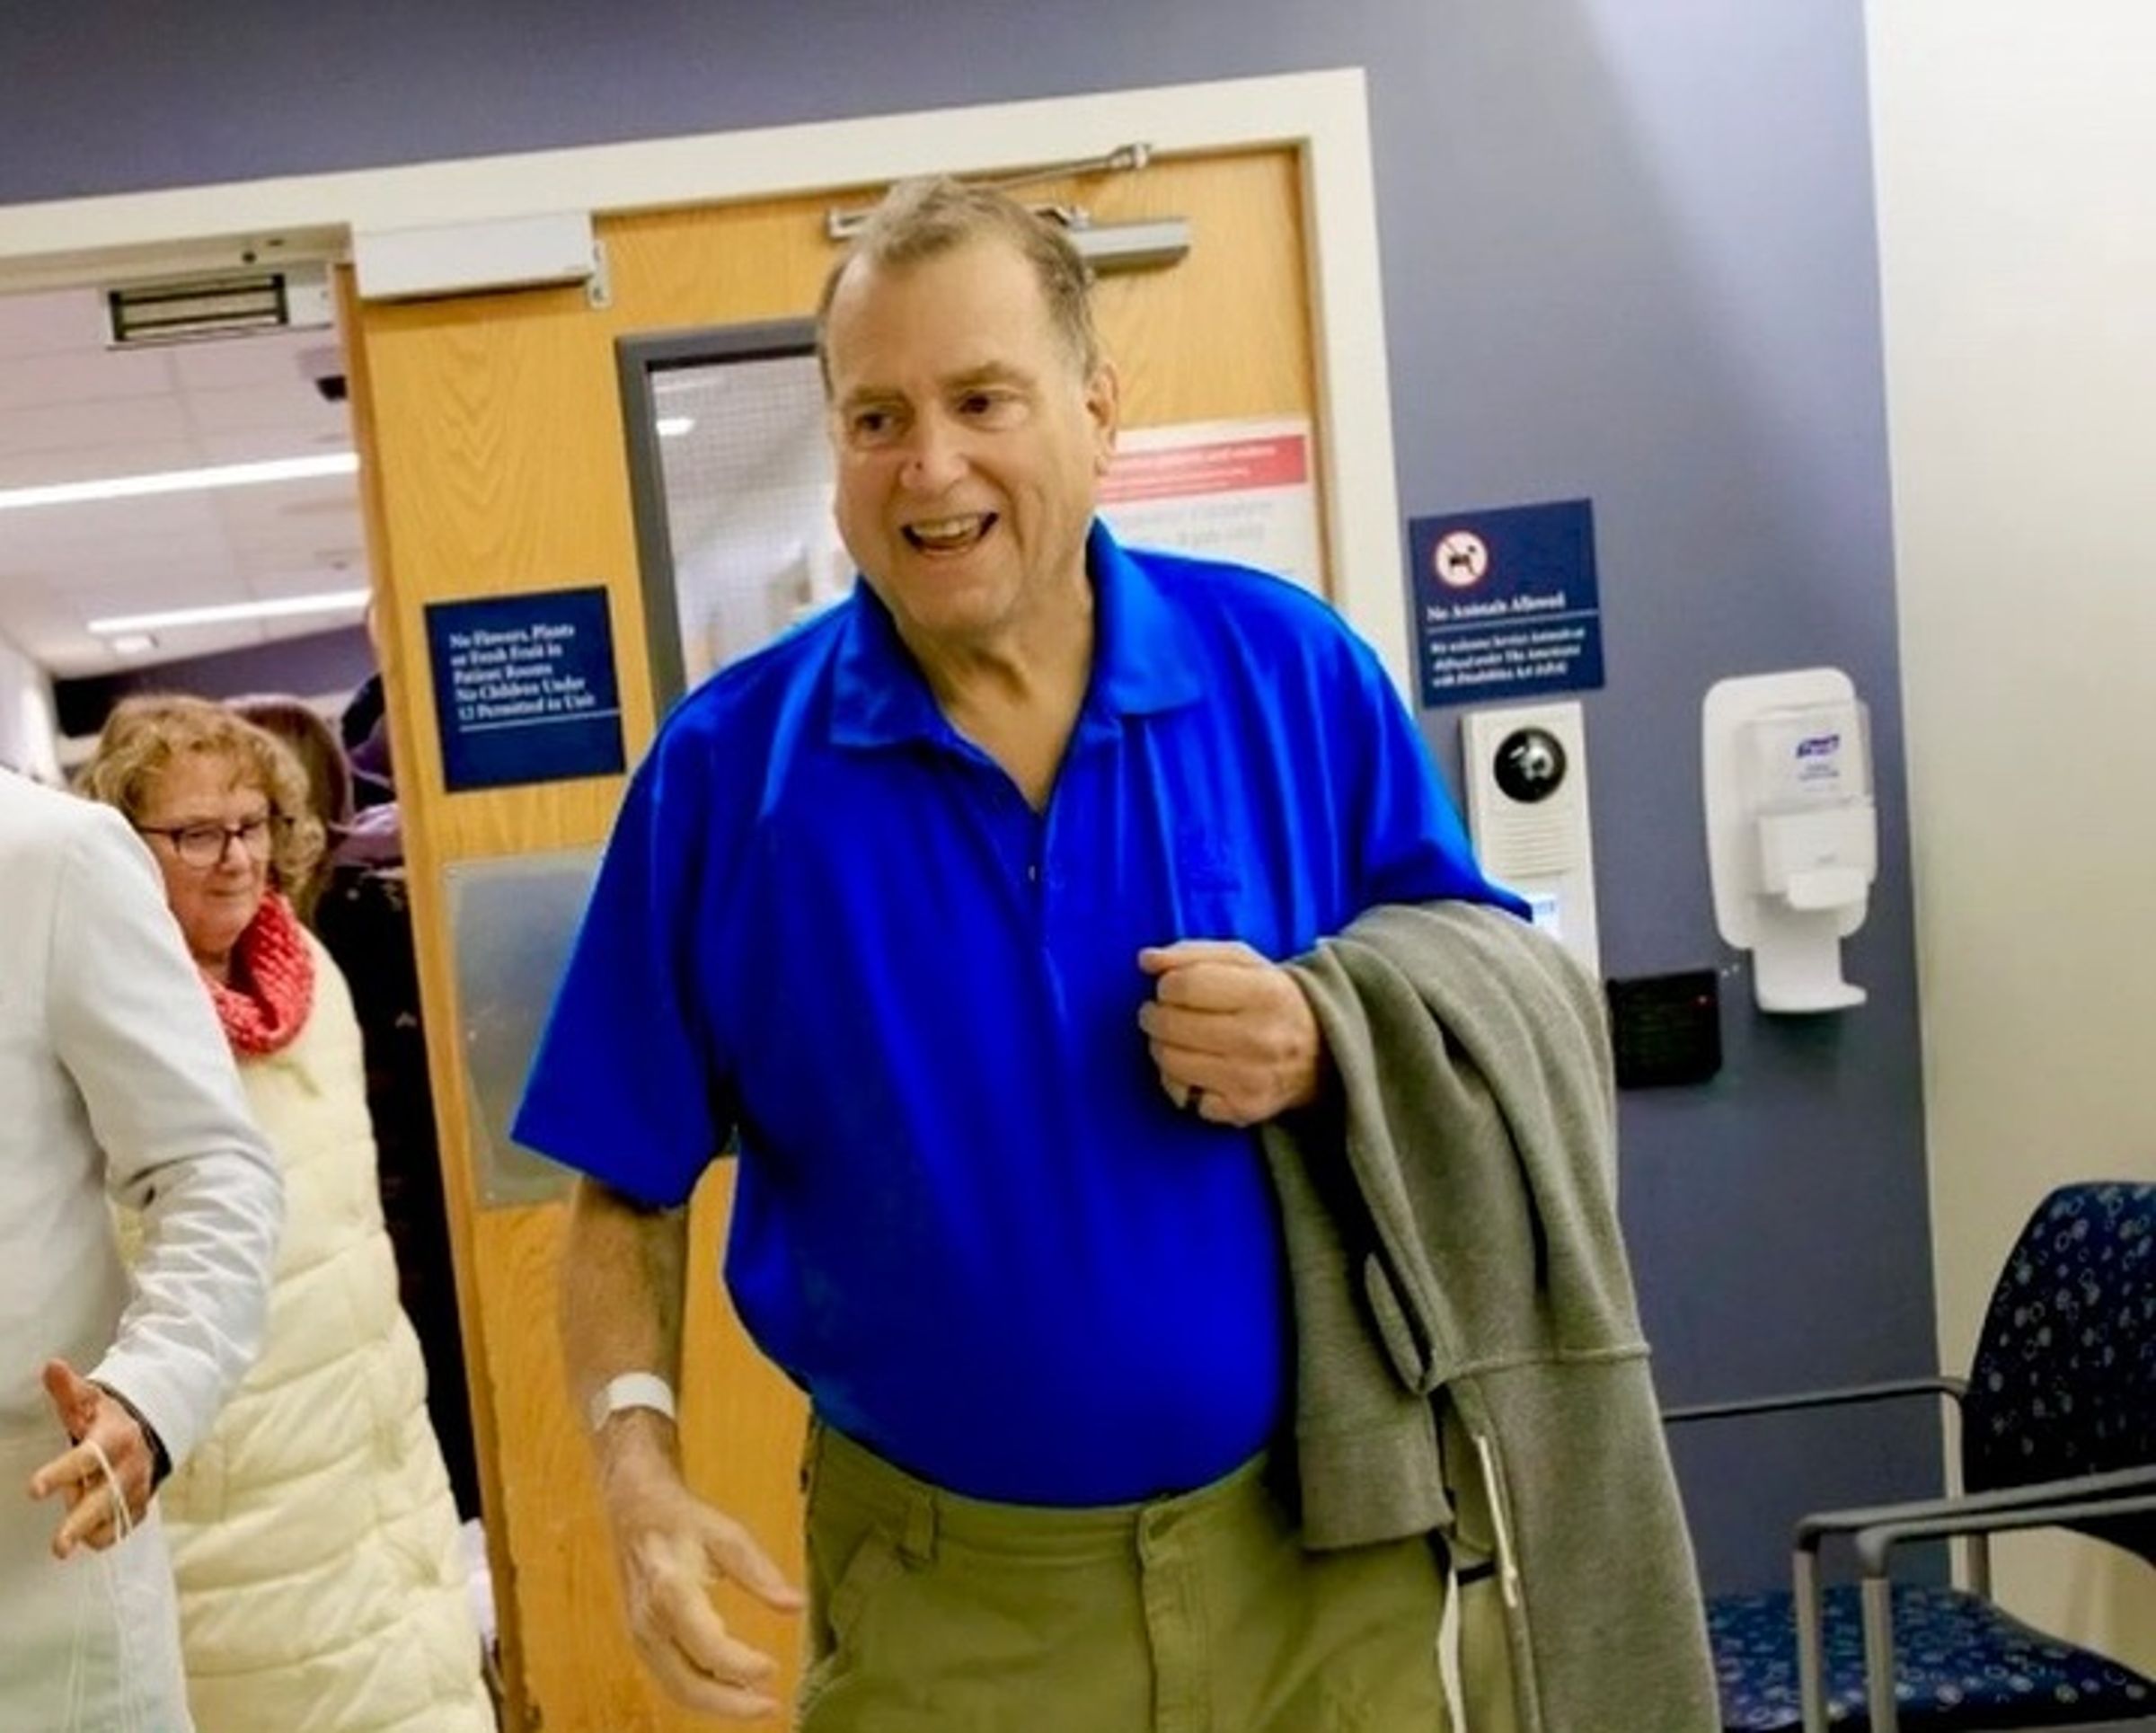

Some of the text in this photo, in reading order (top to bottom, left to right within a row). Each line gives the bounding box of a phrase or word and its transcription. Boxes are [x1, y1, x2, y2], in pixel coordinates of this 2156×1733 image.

[1427, 591, 1566, 622] No Animals Allowed
[450, 633, 471, 648] No
[454, 664, 552, 684] Patient Rooms
[456, 675, 585, 702] No Children Under
